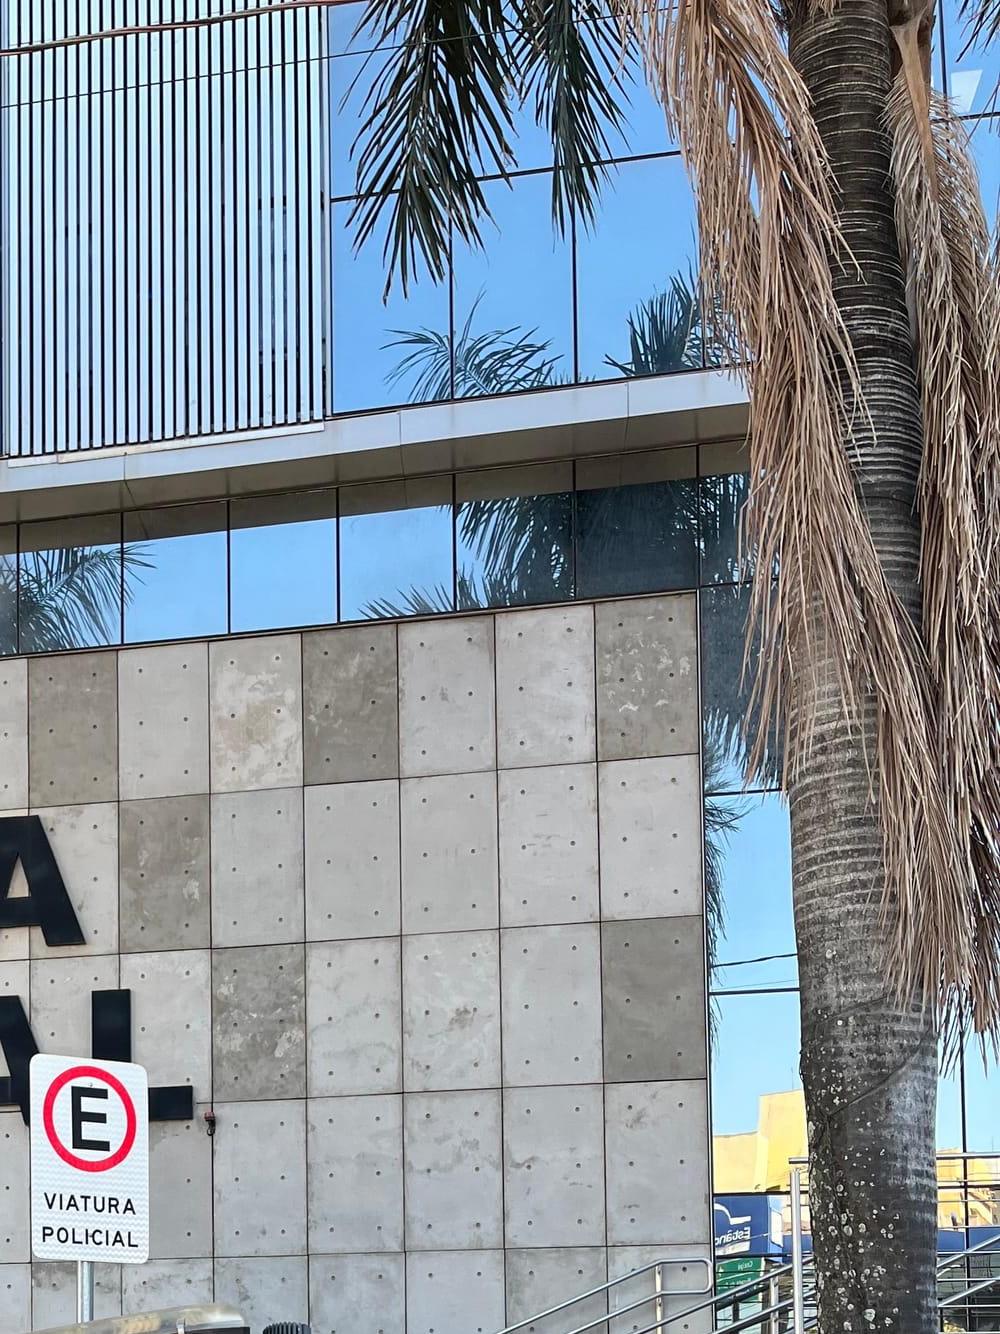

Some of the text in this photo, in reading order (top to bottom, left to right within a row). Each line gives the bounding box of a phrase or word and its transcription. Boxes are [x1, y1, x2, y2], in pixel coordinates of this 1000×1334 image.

[71, 1085, 111, 1152] E
[43, 1192, 136, 1216] VIATURA
[42, 1226, 139, 1248] POLICIAL
